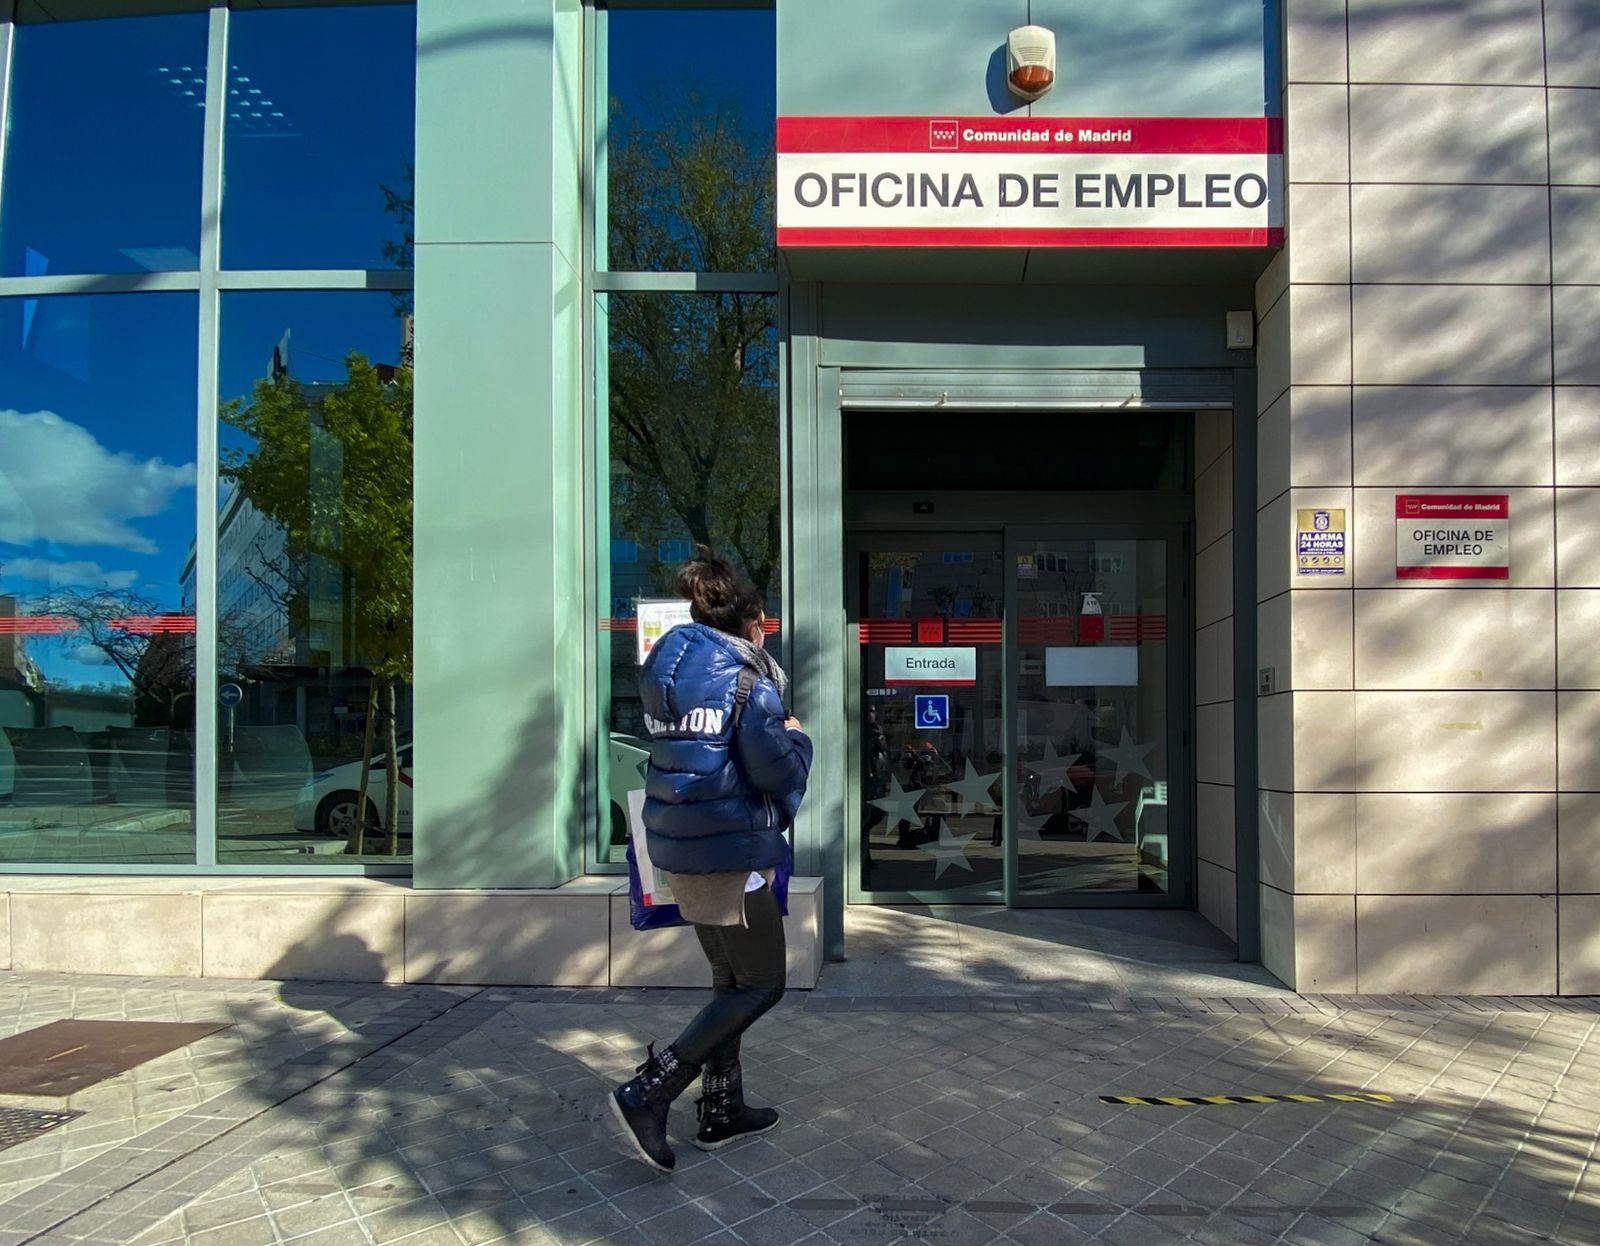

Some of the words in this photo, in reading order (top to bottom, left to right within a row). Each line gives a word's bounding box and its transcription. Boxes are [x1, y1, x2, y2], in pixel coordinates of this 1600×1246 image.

[962, 128, 1050, 142] Comunidad
[1054, 129, 1074, 142] de
[1078, 129, 1132, 142] Madrid
[793, 172, 984, 209] OFICINA
[998, 172, 1062, 209] DE
[1075, 172, 1269, 209] EMPLEO
[1301, 533, 1344, 541] ALARMA
[1412, 529, 1471, 541] OFICINA
[1474, 529, 1494, 541] DE
[1424, 544, 1483, 556] EMPLEO
[906, 657, 956, 669] Entrada
